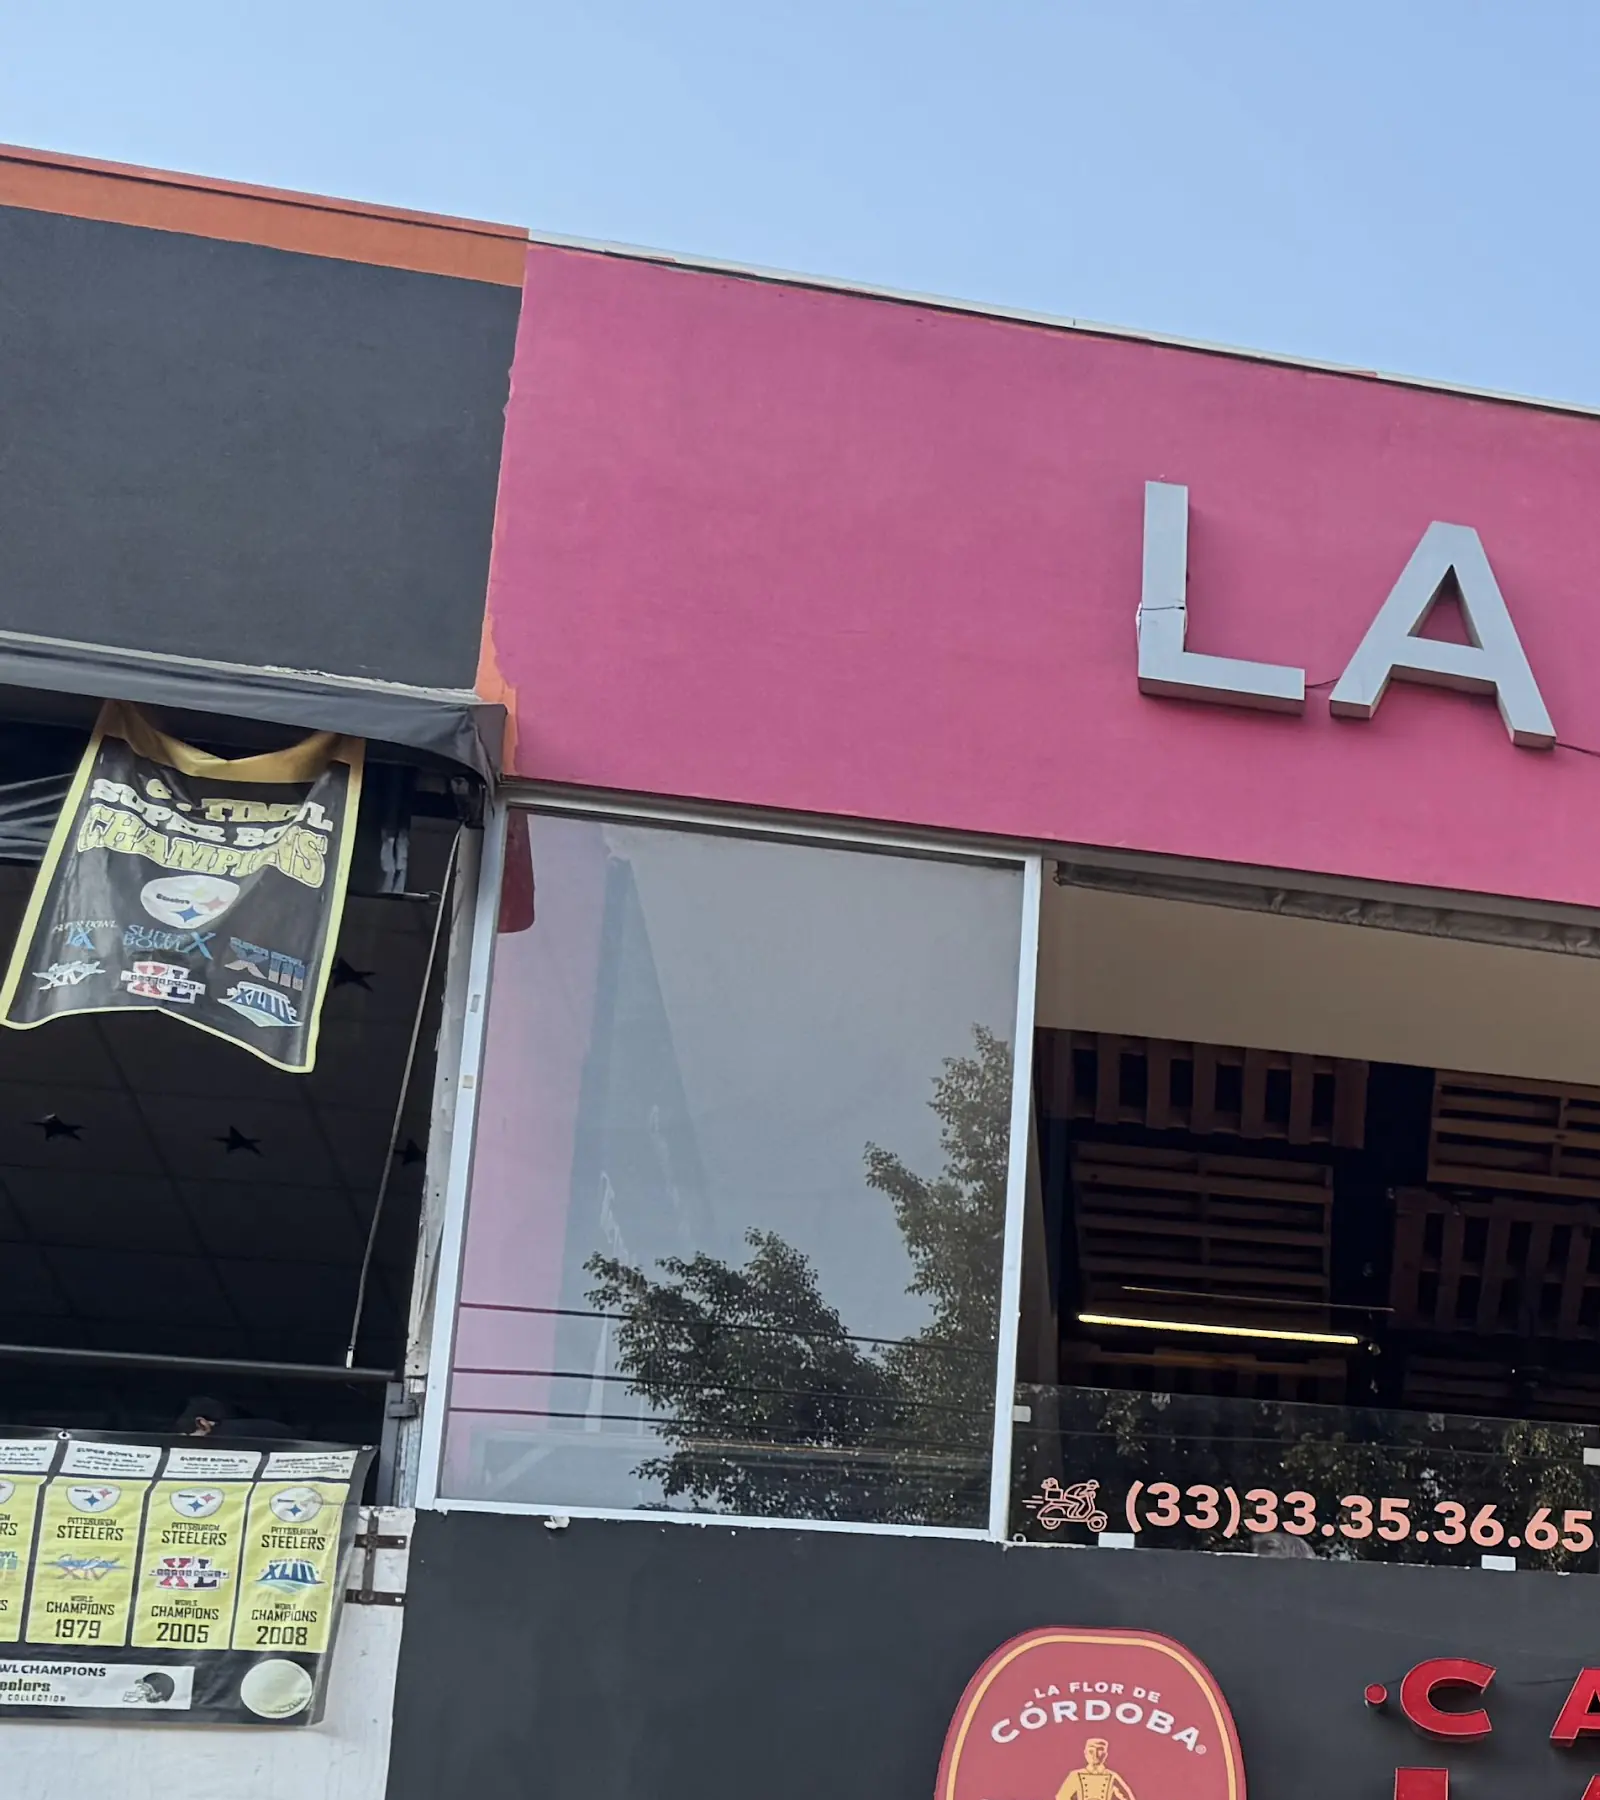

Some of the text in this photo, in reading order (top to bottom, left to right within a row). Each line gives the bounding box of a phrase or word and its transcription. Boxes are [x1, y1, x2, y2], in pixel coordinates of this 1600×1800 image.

[1136, 480, 1557, 750] LA
[1125, 1480, 1595, 1553] (33)33.35.36.65
[57, 1525, 124, 1541] STEELERS
[161, 1530, 227, 1546] STEELERS
[261, 1534, 326, 1550] STEELERS
[46, 1601, 116, 1616] CHAMPIONS
[151, 1605, 219, 1621] CHAMPIONS
[251, 1609, 318, 1623] CHAMPIONS
[55, 1618, 102, 1639] 1979
[156, 1622, 210, 1644] 2005
[256, 1625, 309, 1646] 2008
[21, 1664, 107, 1677] CHAMPIONS
[1034, 1681, 1161, 1703] LA FLOR DE
